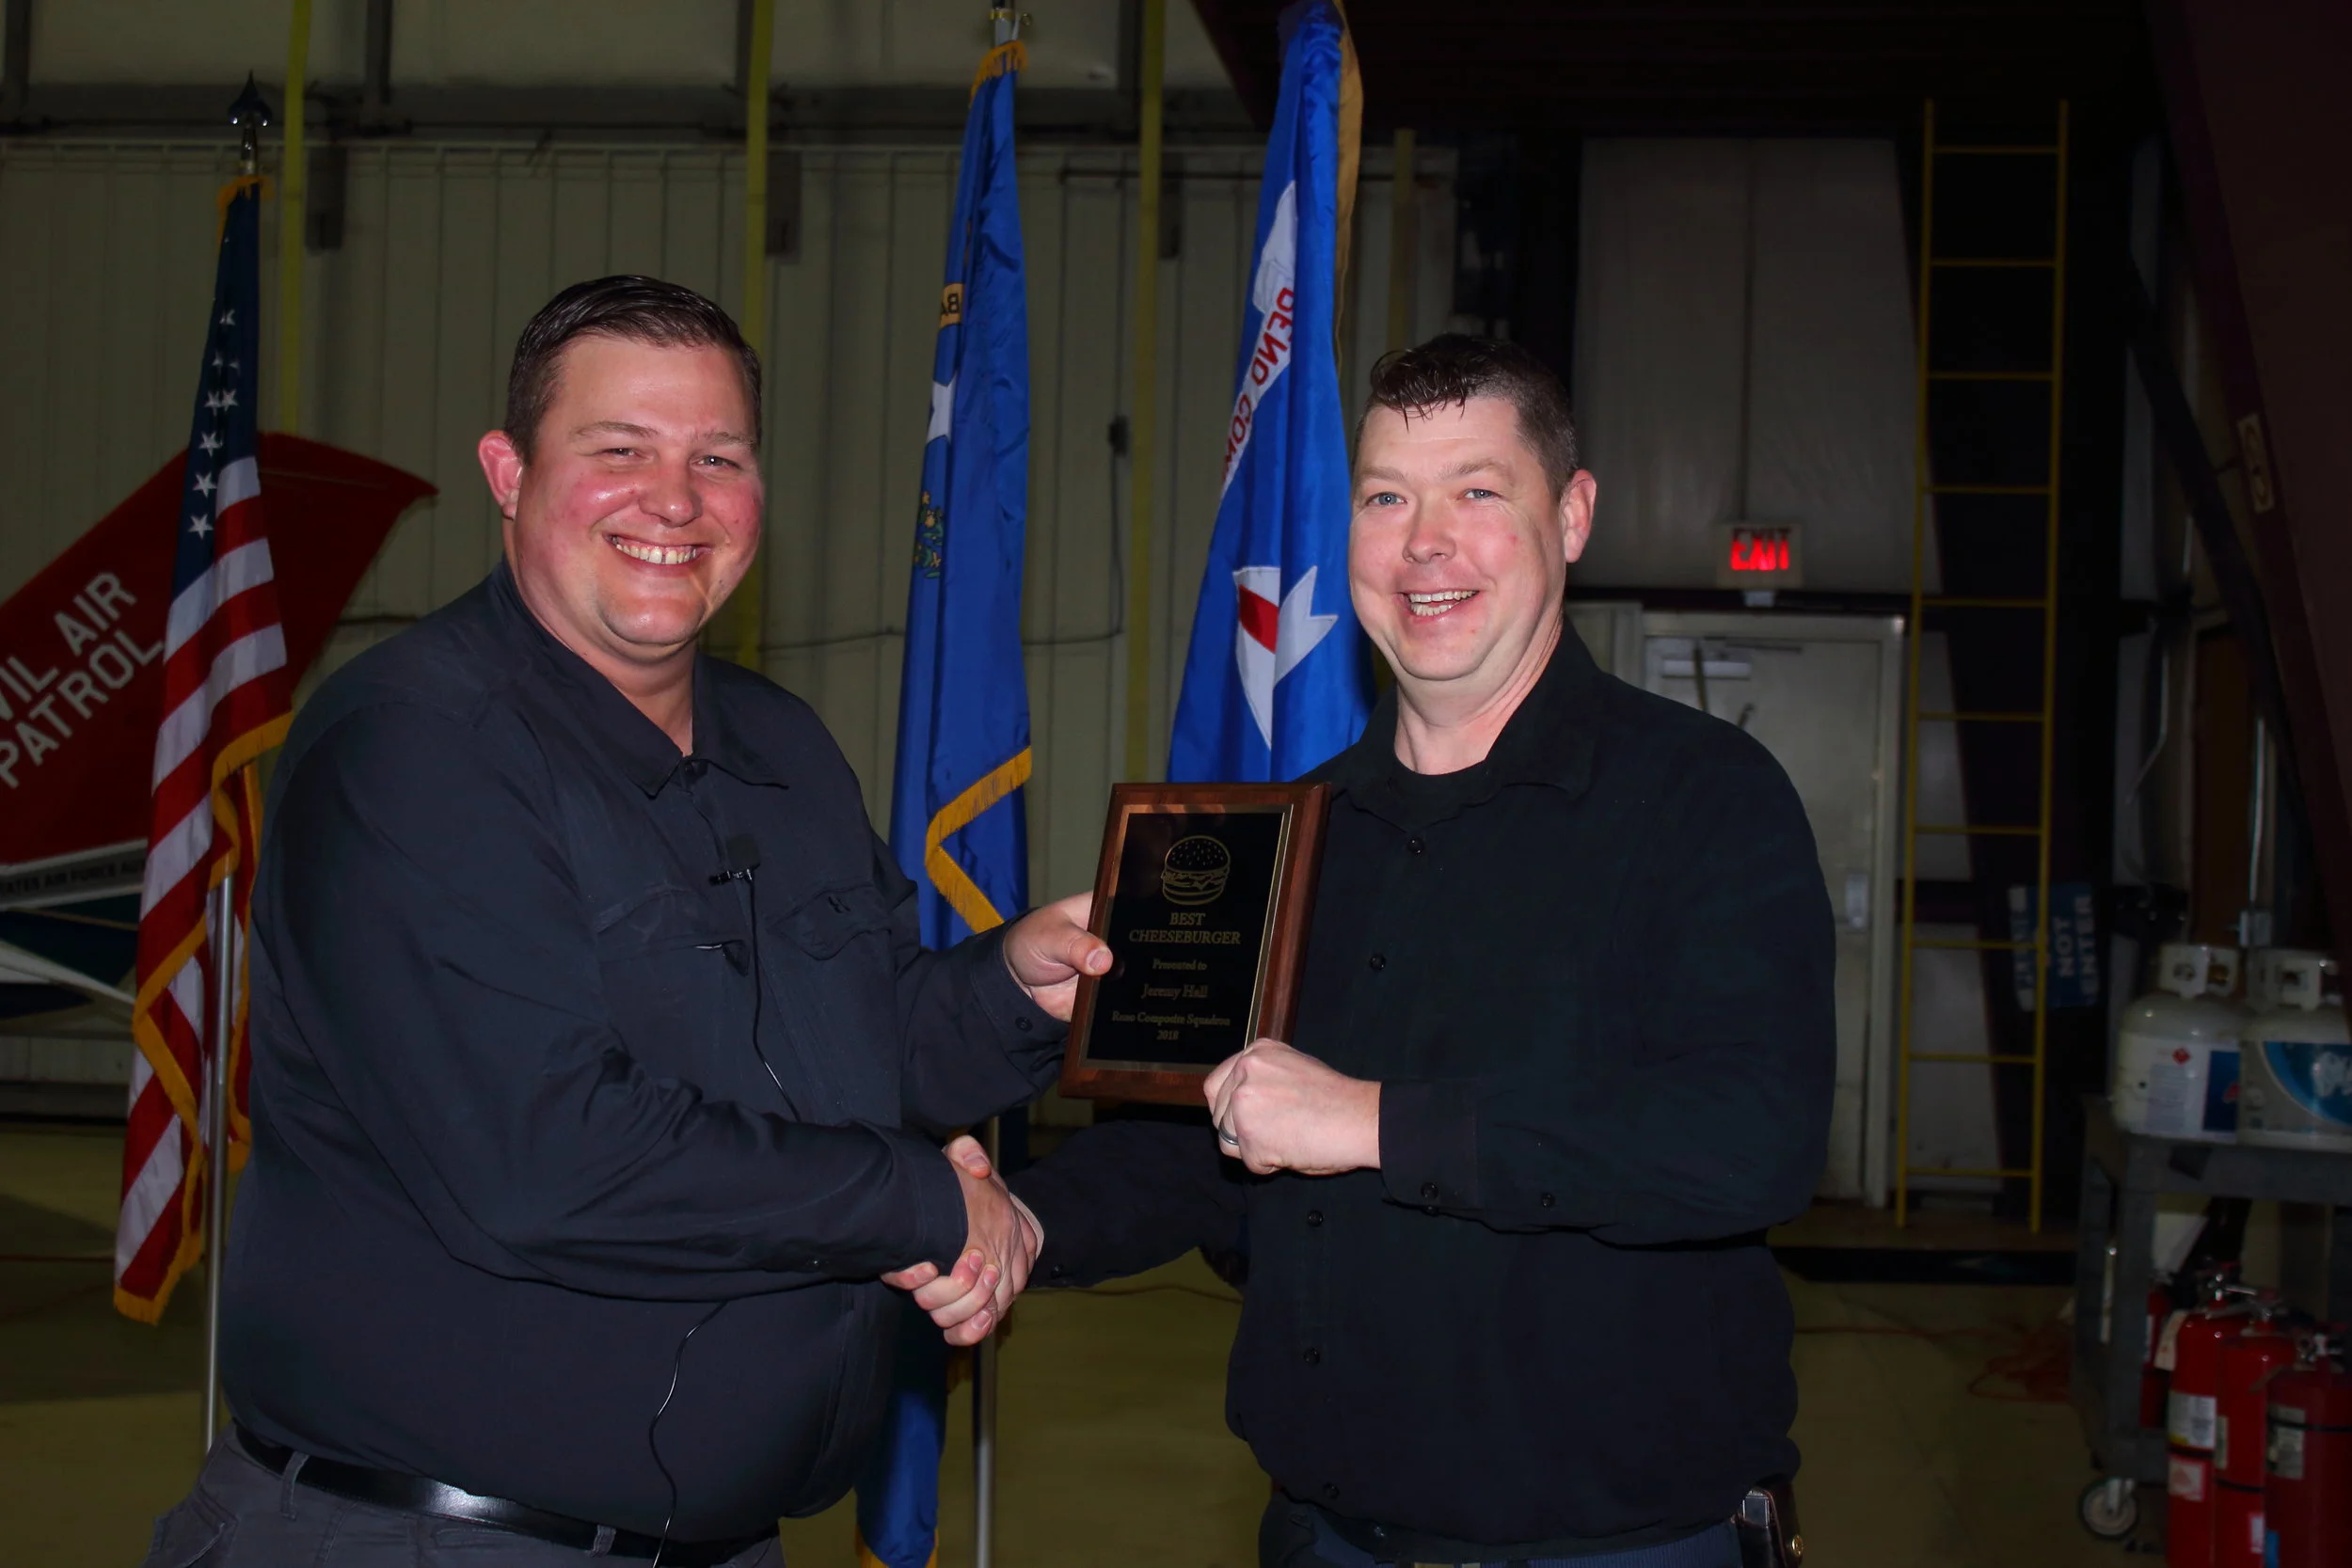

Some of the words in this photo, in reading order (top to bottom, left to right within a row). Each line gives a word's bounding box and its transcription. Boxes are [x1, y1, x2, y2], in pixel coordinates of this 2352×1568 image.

[1730, 528, 1791, 571] EXIT
[53, 570, 137, 657] AIR
[0, 629, 164, 789] PATROL
[1168, 911, 1206, 927] BEST
[1129, 929, 1242, 945] CHEESEBURGER
[2052, 915, 2075, 978] NOT
[2074, 895, 2100, 995] ENTER
[1152, 958, 1197, 971] Presented
[1197, 959, 1208, 971] to
[1182, 984, 1209, 998] Hall
[1111, 1010, 1136, 1022] Reno
[1136, 1011, 1186, 1027] Composite
[1186, 1013, 1232, 1028] Squadron
